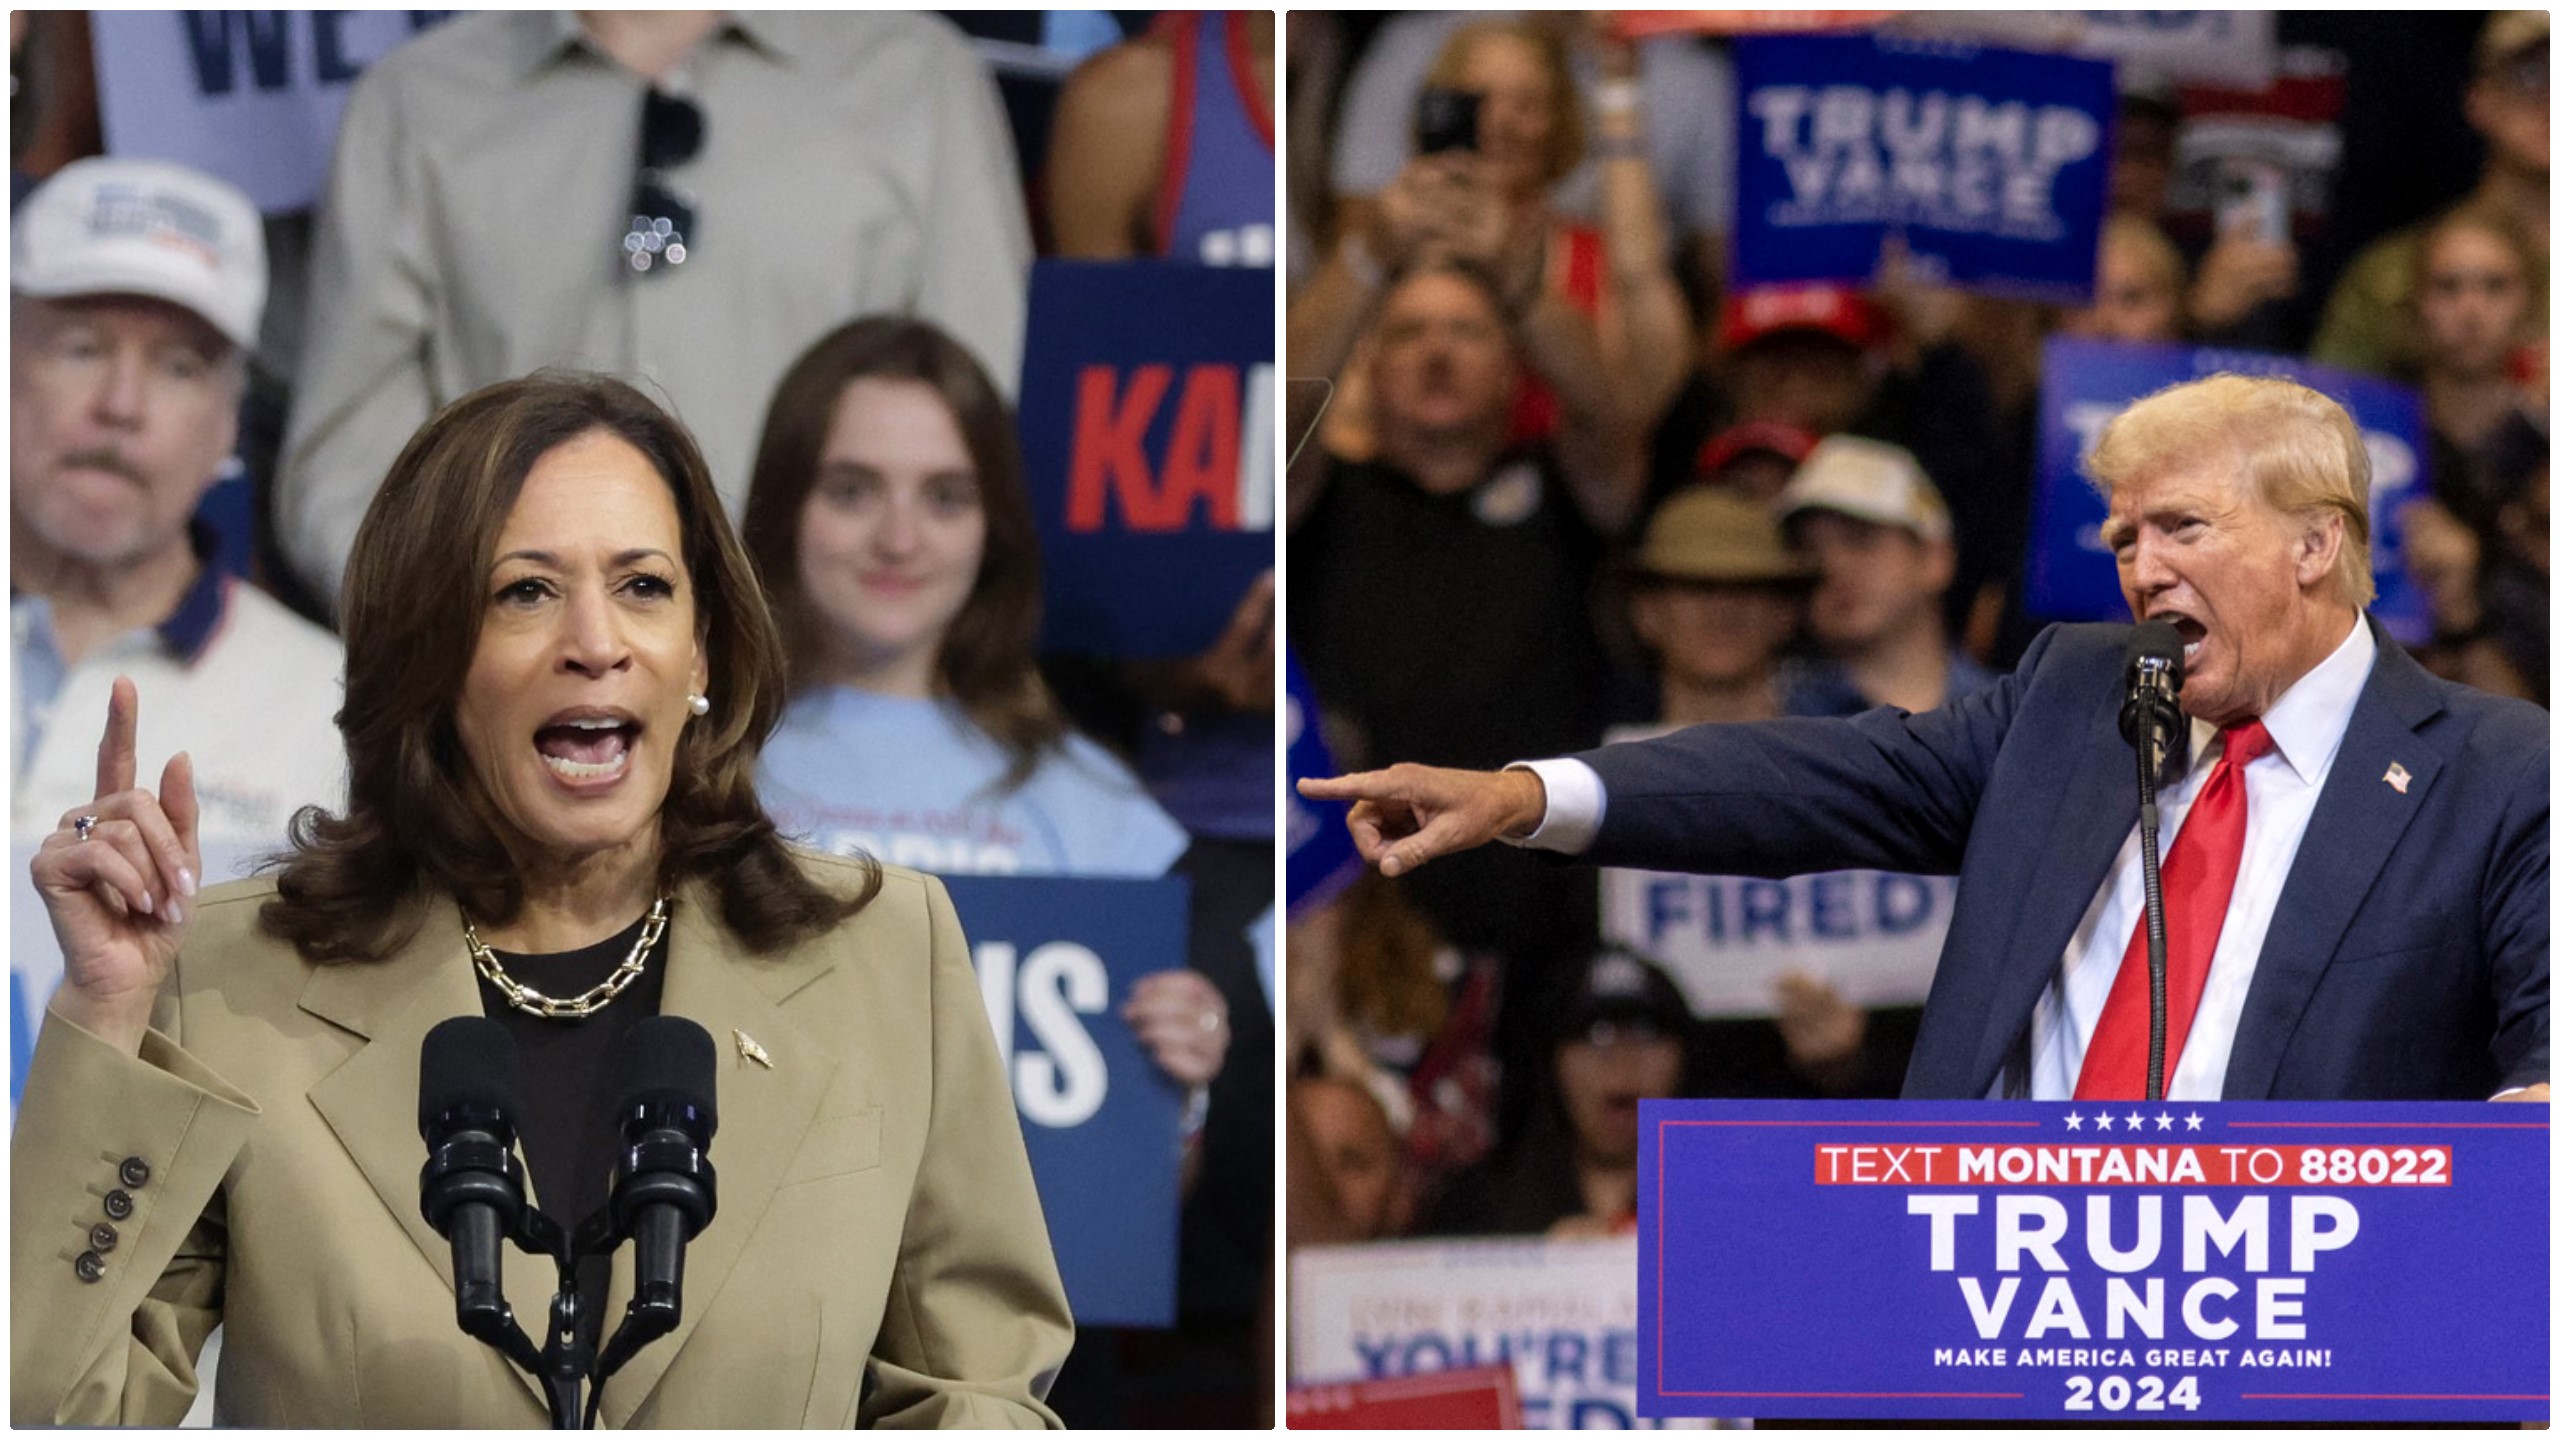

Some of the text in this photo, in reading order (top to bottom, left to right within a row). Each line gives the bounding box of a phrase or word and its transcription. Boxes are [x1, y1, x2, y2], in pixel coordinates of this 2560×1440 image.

[1747, 84, 2100, 166] TRUMP
[1782, 140, 2058, 222] VANCE
[1066, 362, 1275, 532] KA
[1821, 1147, 2447, 1184] TEXT MONTANA TO 88022
[1907, 1194, 2360, 1273] TRUMP
[1957, 1276, 2307, 1341] VANCE
[1934, 1348, 2332, 1368] MAKE AMERICA GREAT AGAIN!
[2063, 1375, 2201, 1411] 2024
